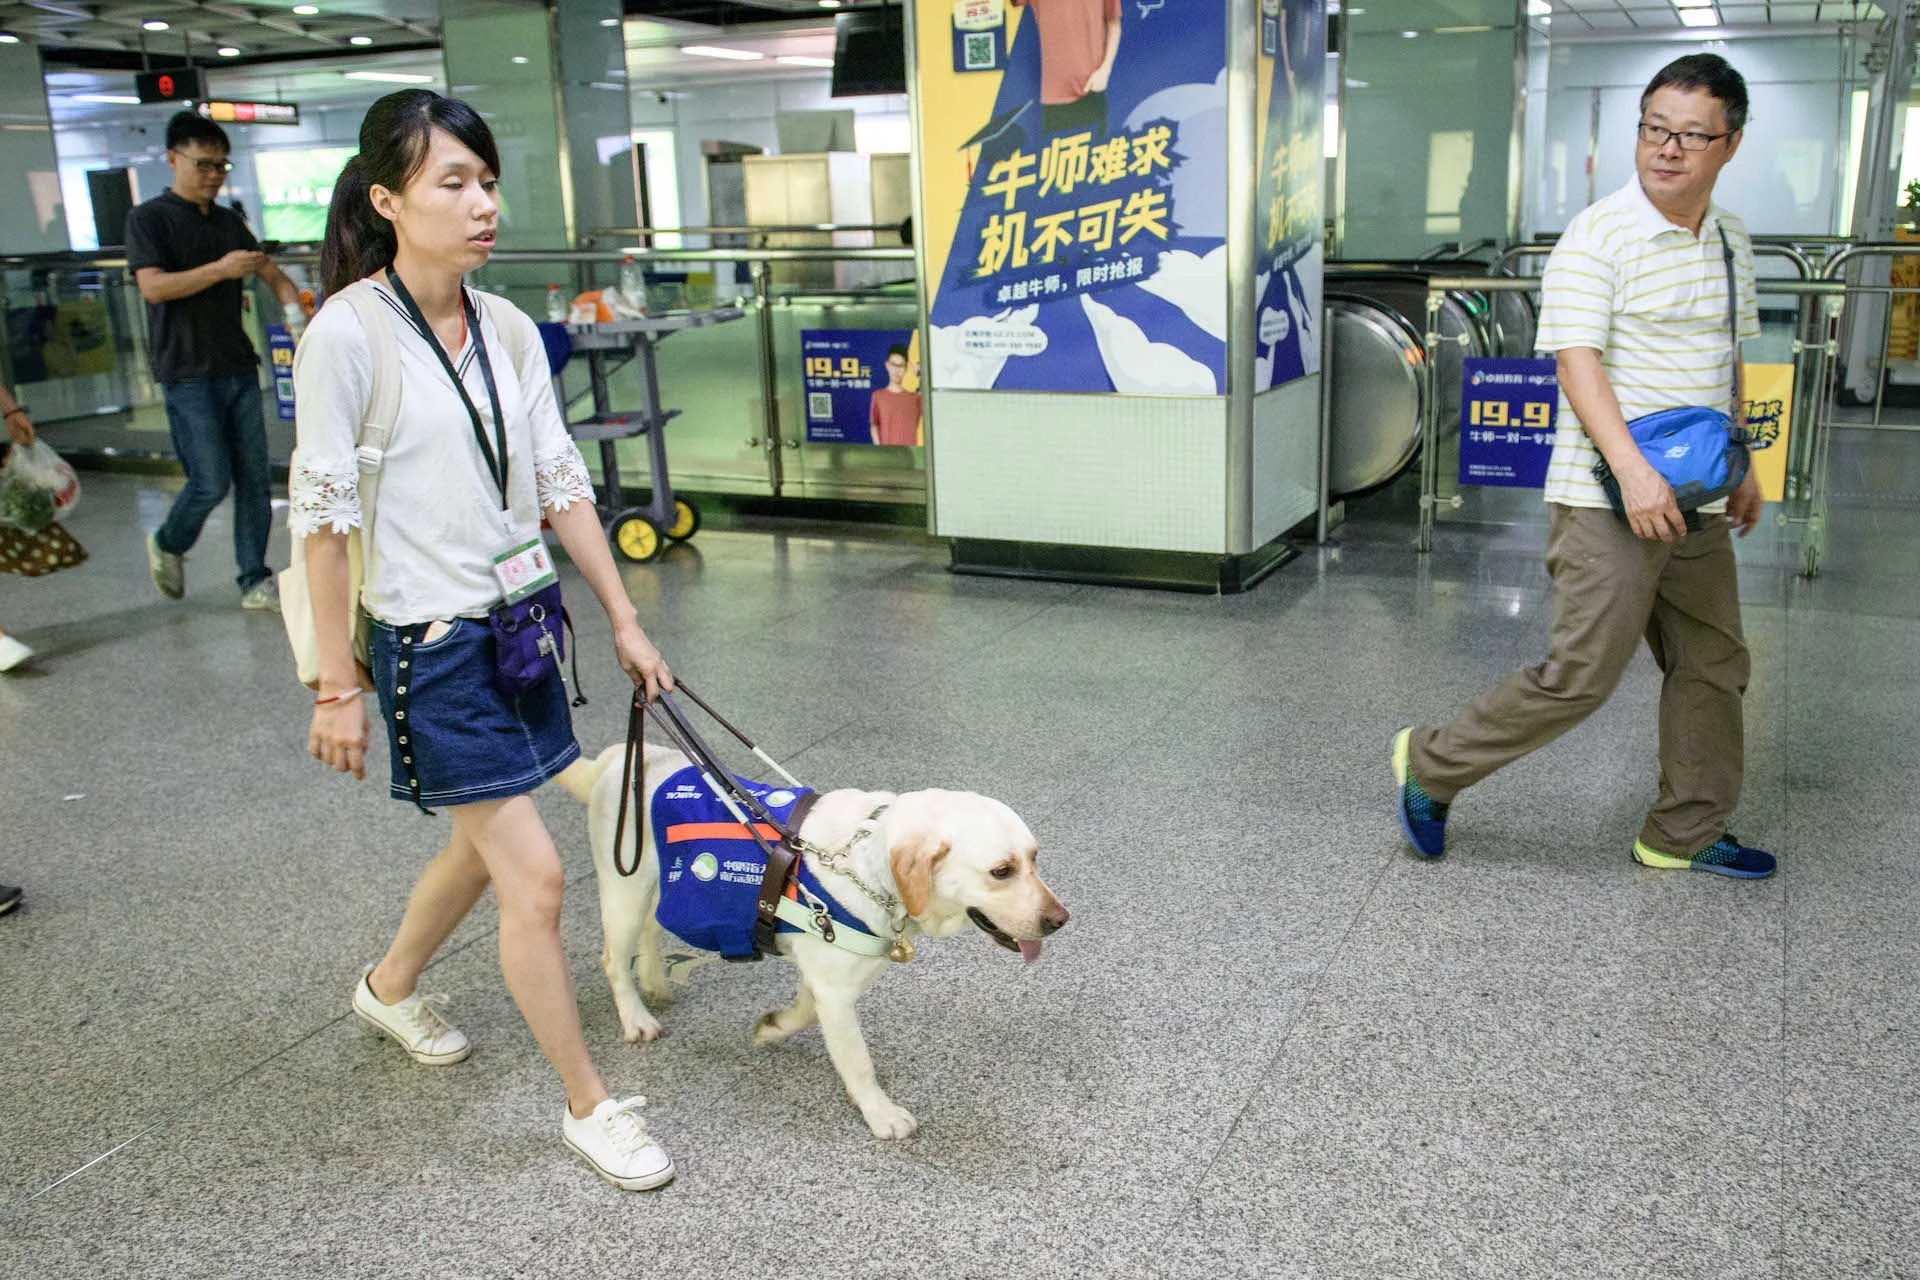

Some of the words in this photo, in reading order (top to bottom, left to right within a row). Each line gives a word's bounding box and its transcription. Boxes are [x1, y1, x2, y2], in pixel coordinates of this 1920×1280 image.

[981, 125, 1172, 211] 牛师难求
[972, 187, 1169, 279] 机不可失
[996, 256, 1144, 303] 卓越牛师，限时抢报
[1470, 400, 1551, 428] 19.9
